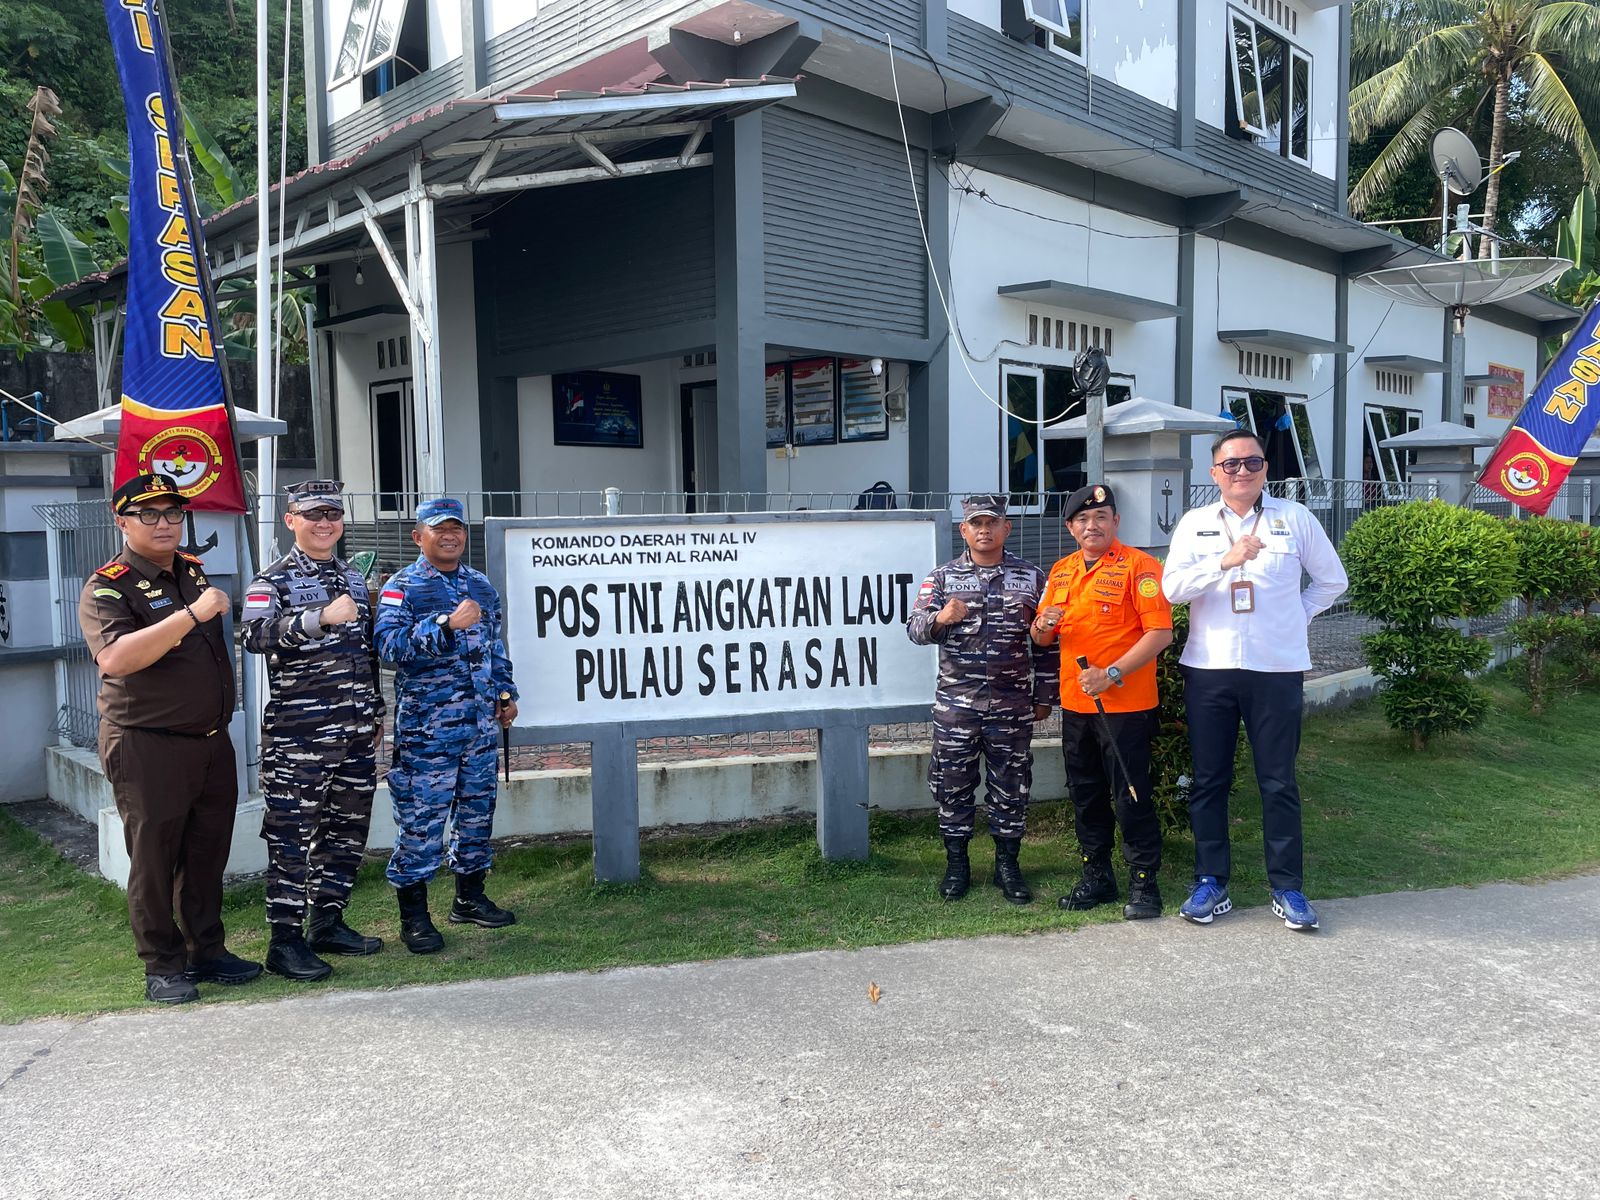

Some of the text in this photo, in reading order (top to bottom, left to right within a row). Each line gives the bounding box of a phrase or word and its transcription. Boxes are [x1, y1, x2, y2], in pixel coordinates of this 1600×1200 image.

[1544, 321, 1600, 423] ASAN
[531, 532, 757, 550] KOMANDO DAERAH TNI AL IV
[532, 549, 738, 568] PANGKALAN TNI AL RANAI
[949, 583, 978, 591] TONY
[1096, 578, 1123, 589] BASARNAS
[299, 592, 319, 602] ADY
[535, 573, 913, 639] POS TNI ANGKATAN LAUT
[575, 636, 878, 702] PULAU SERASAN
